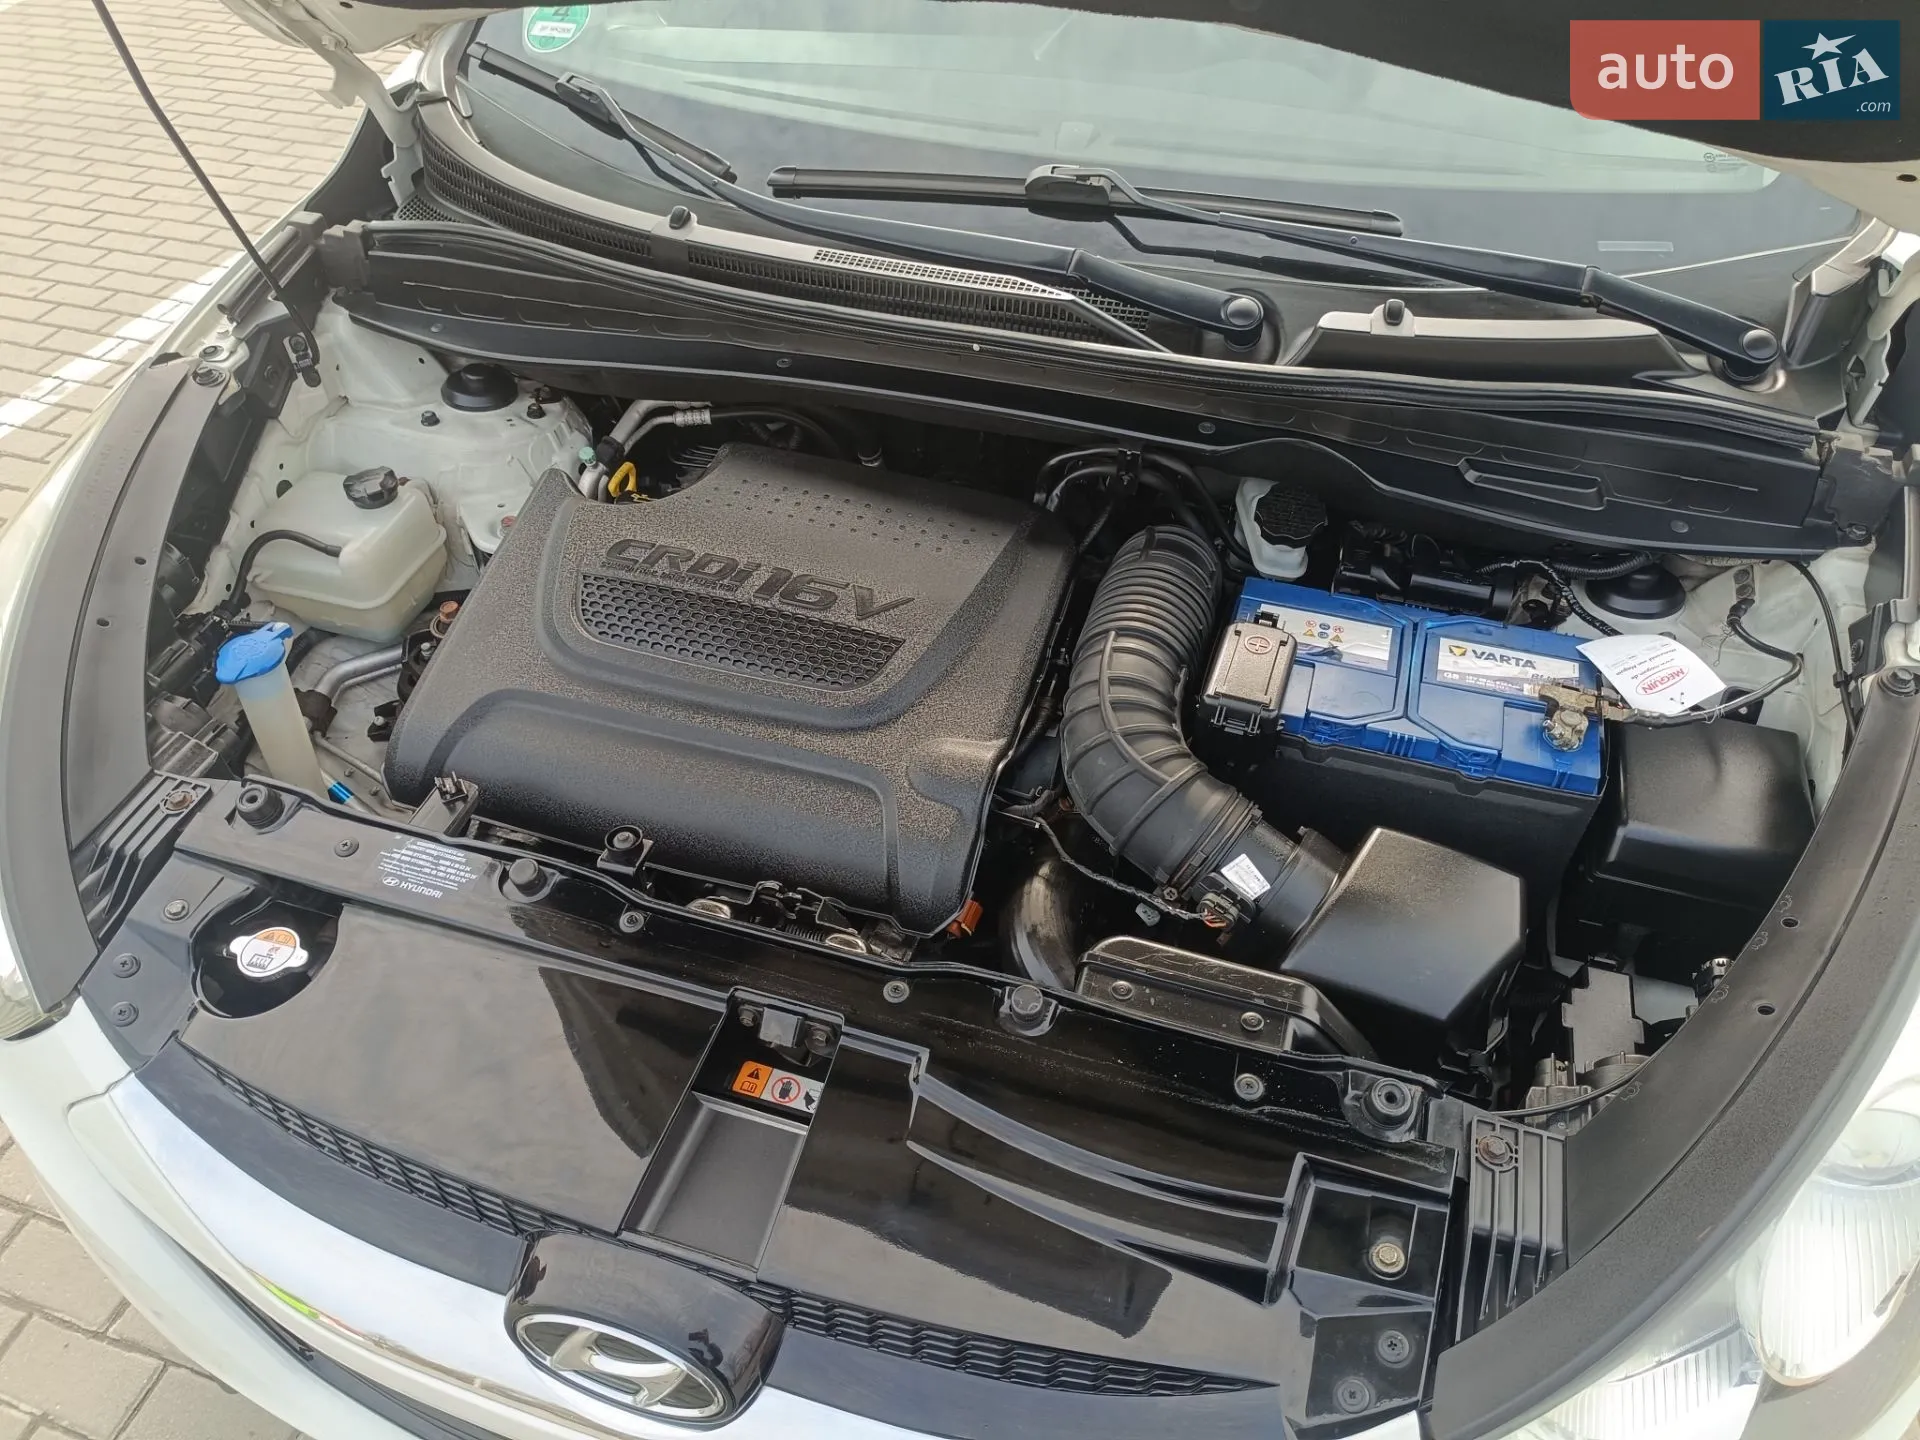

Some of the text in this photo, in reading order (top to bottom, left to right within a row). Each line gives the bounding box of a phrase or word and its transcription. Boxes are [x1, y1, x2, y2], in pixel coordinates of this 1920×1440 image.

[1471, 649, 1536, 670] VARTA
[1641, 668, 1685, 693] MEGUIN
[400, 881, 443, 898] HYUNDAI
